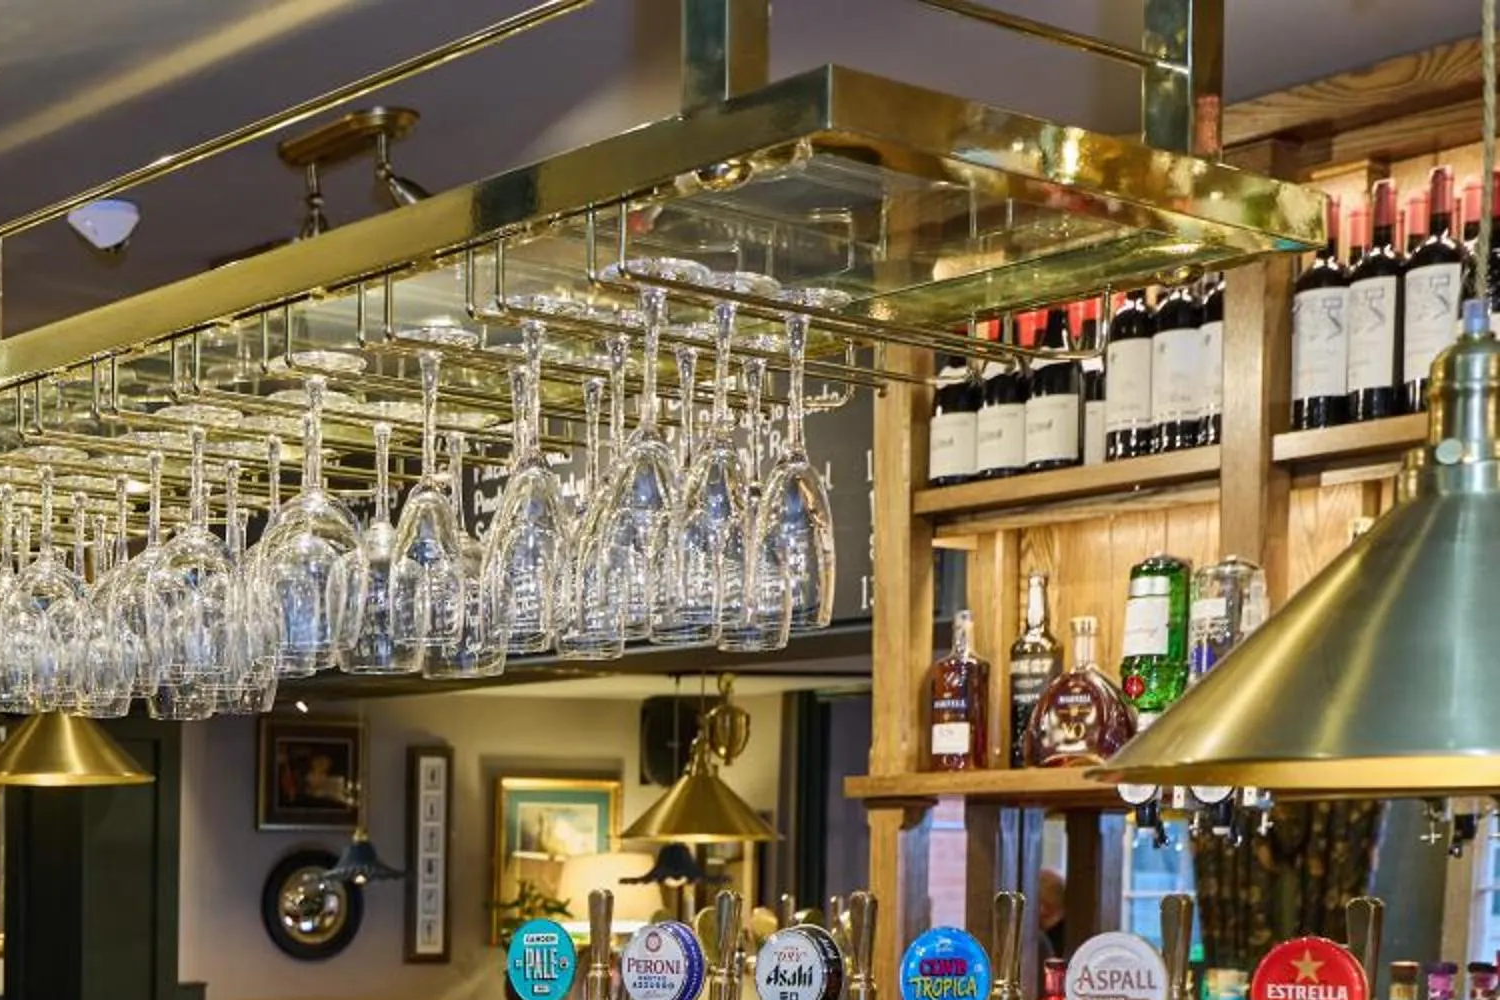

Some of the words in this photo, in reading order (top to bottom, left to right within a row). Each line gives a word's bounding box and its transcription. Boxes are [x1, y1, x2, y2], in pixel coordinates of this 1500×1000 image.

[524, 947, 558, 979] PALE
[627, 957, 681, 975] PERONI
[765, 964, 814, 988] Asahi
[1074, 964, 1157, 991] ASPALL
